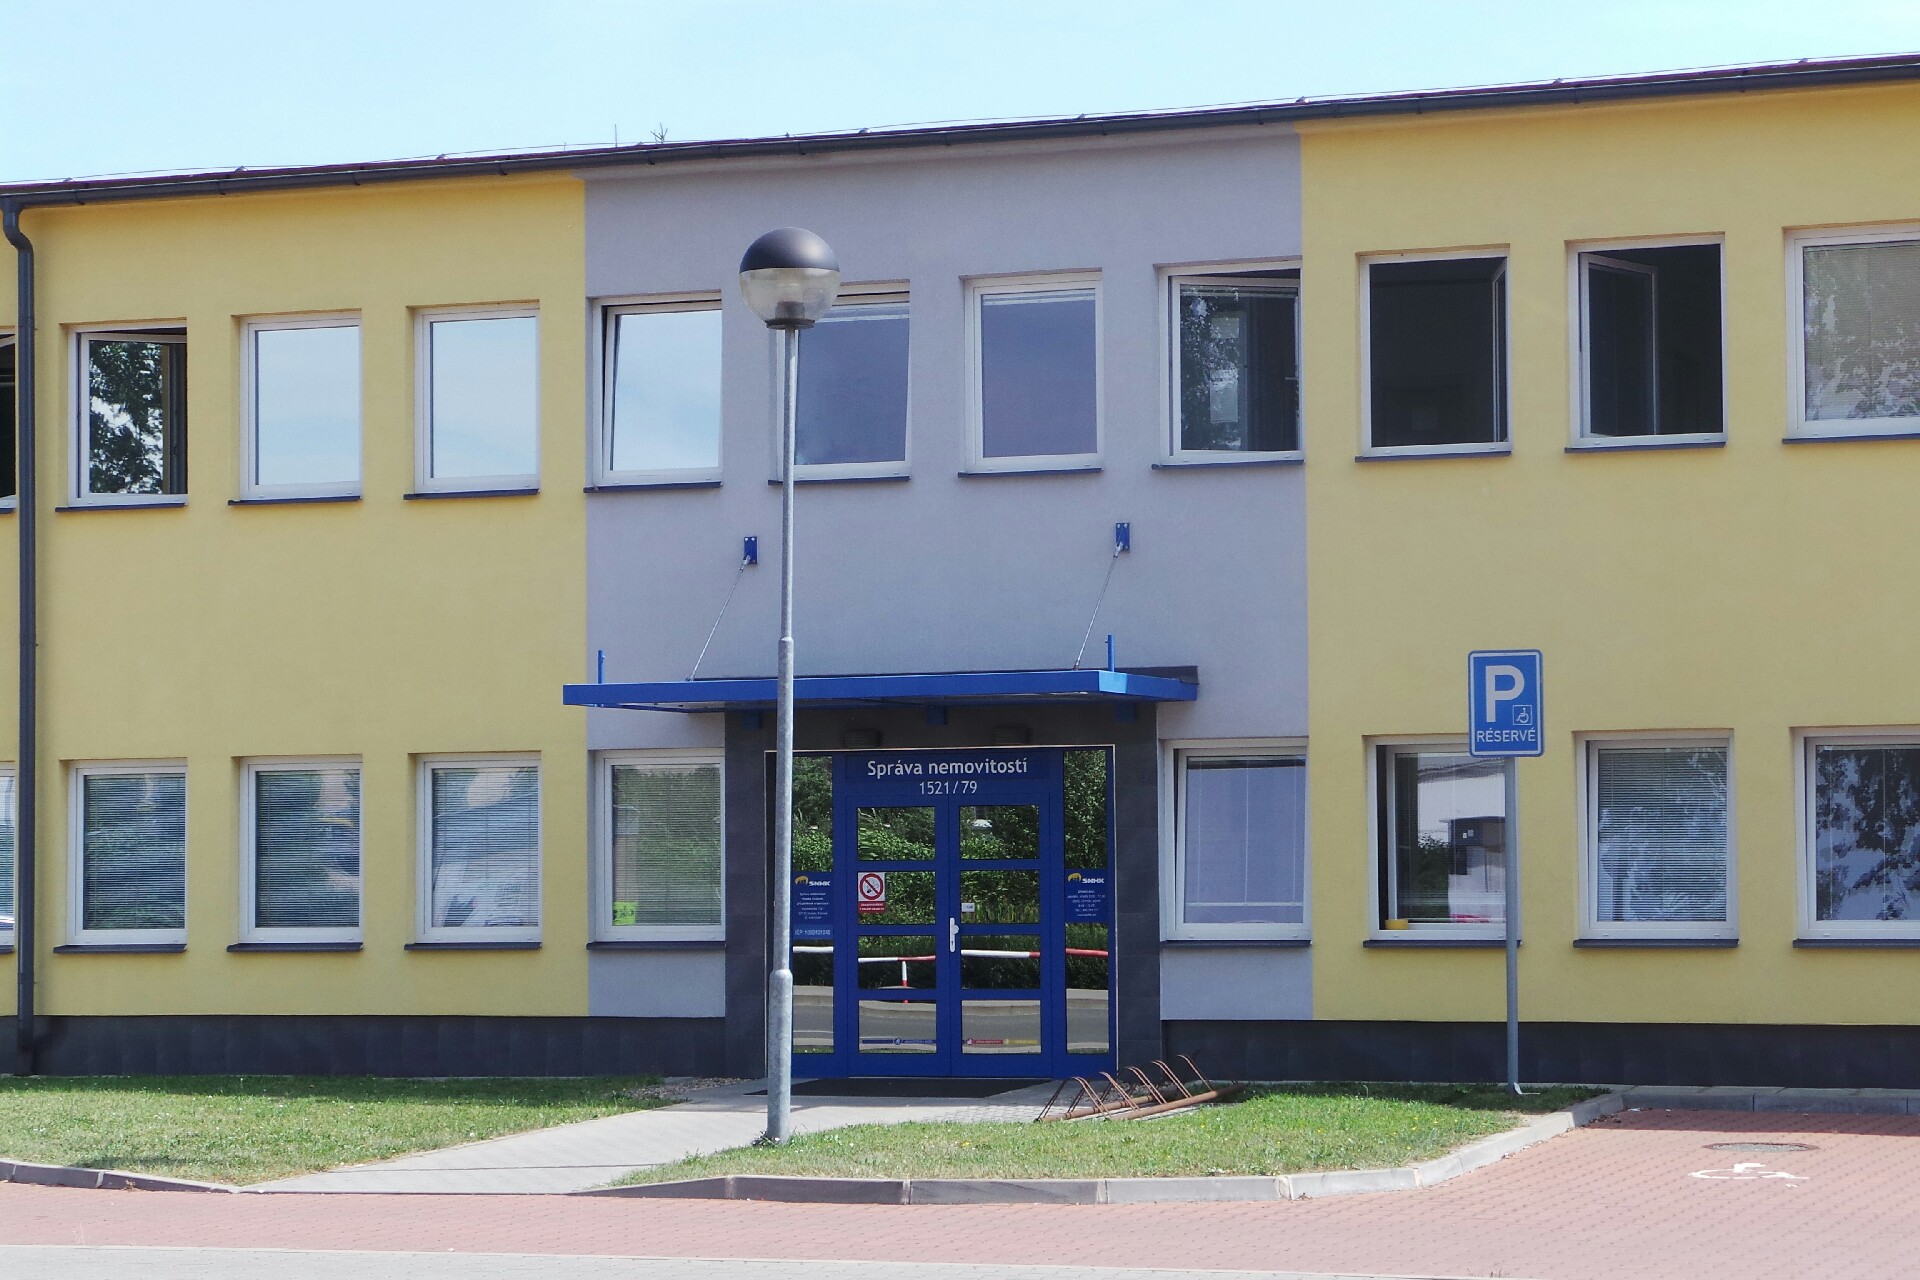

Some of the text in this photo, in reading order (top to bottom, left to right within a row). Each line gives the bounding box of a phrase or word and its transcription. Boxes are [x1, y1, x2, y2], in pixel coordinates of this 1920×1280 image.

[1485, 664, 1525, 723] P
[1476, 727, 1536, 743] RÉSERVÉ
[867, 758, 1028, 779] Správa nemovitostí
